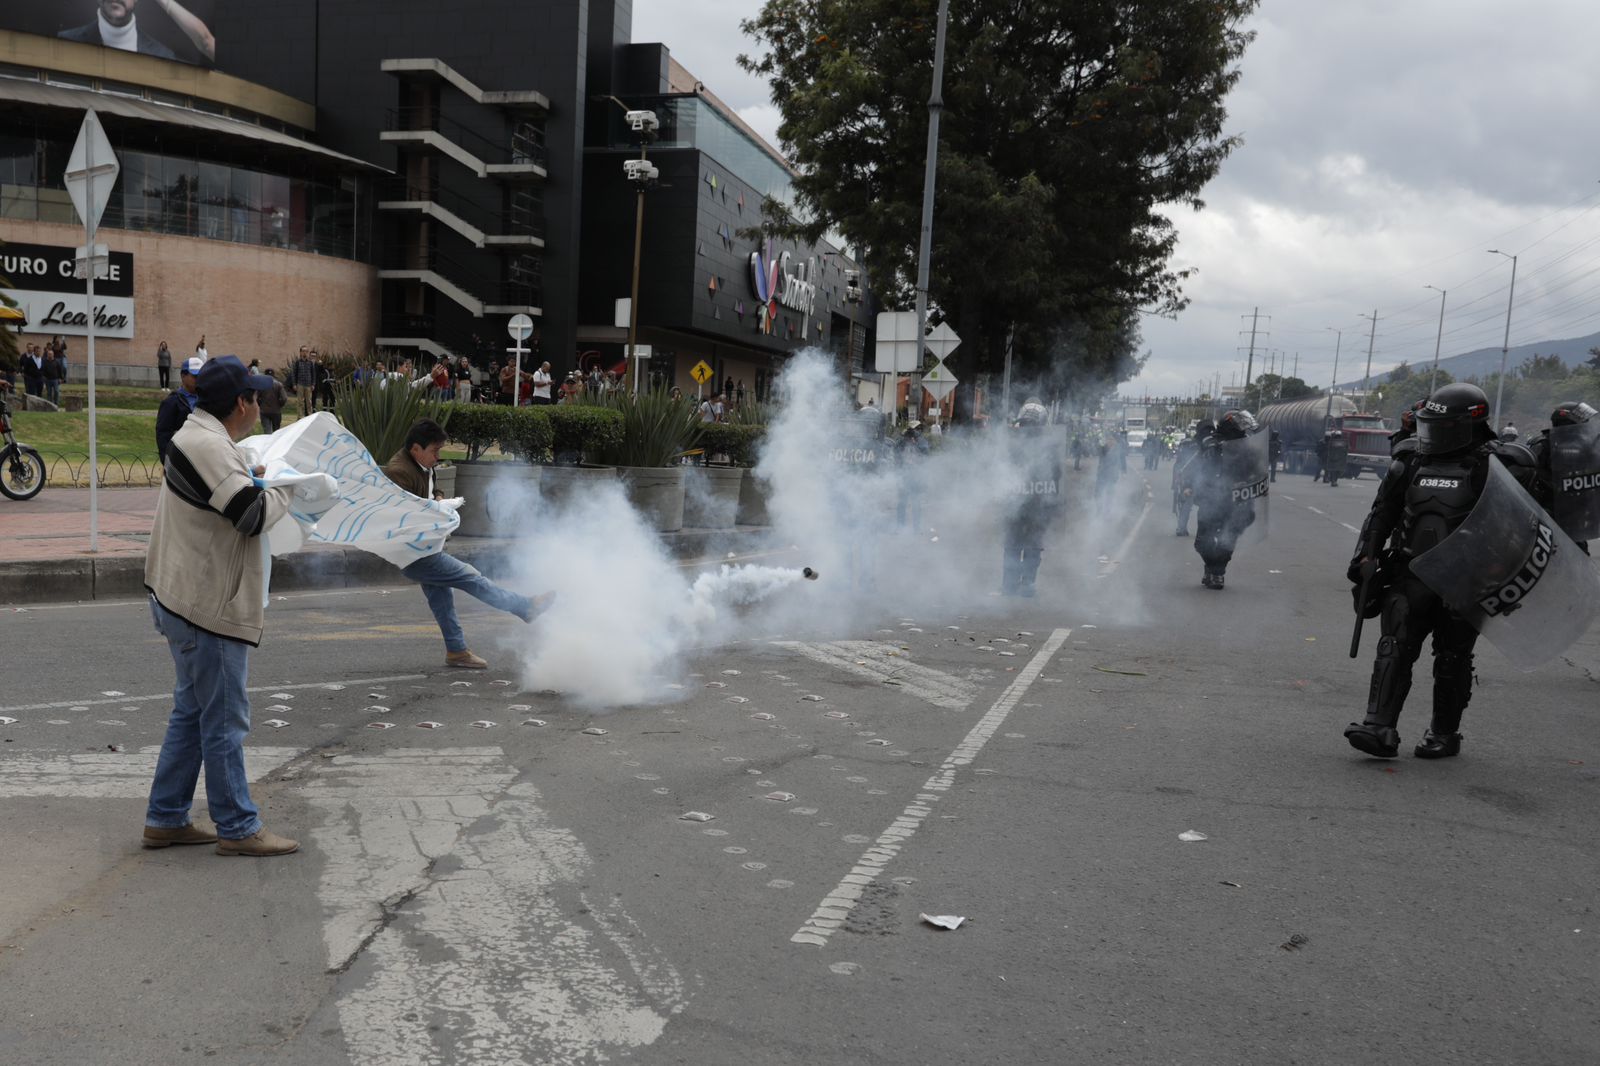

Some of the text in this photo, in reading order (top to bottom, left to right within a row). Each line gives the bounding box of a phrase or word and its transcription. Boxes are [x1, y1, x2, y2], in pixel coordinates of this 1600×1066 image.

[0, 254, 48, 275] URO
[1419, 478, 1459, 488] 038253
[1479, 523, 1552, 615] POLICIA
